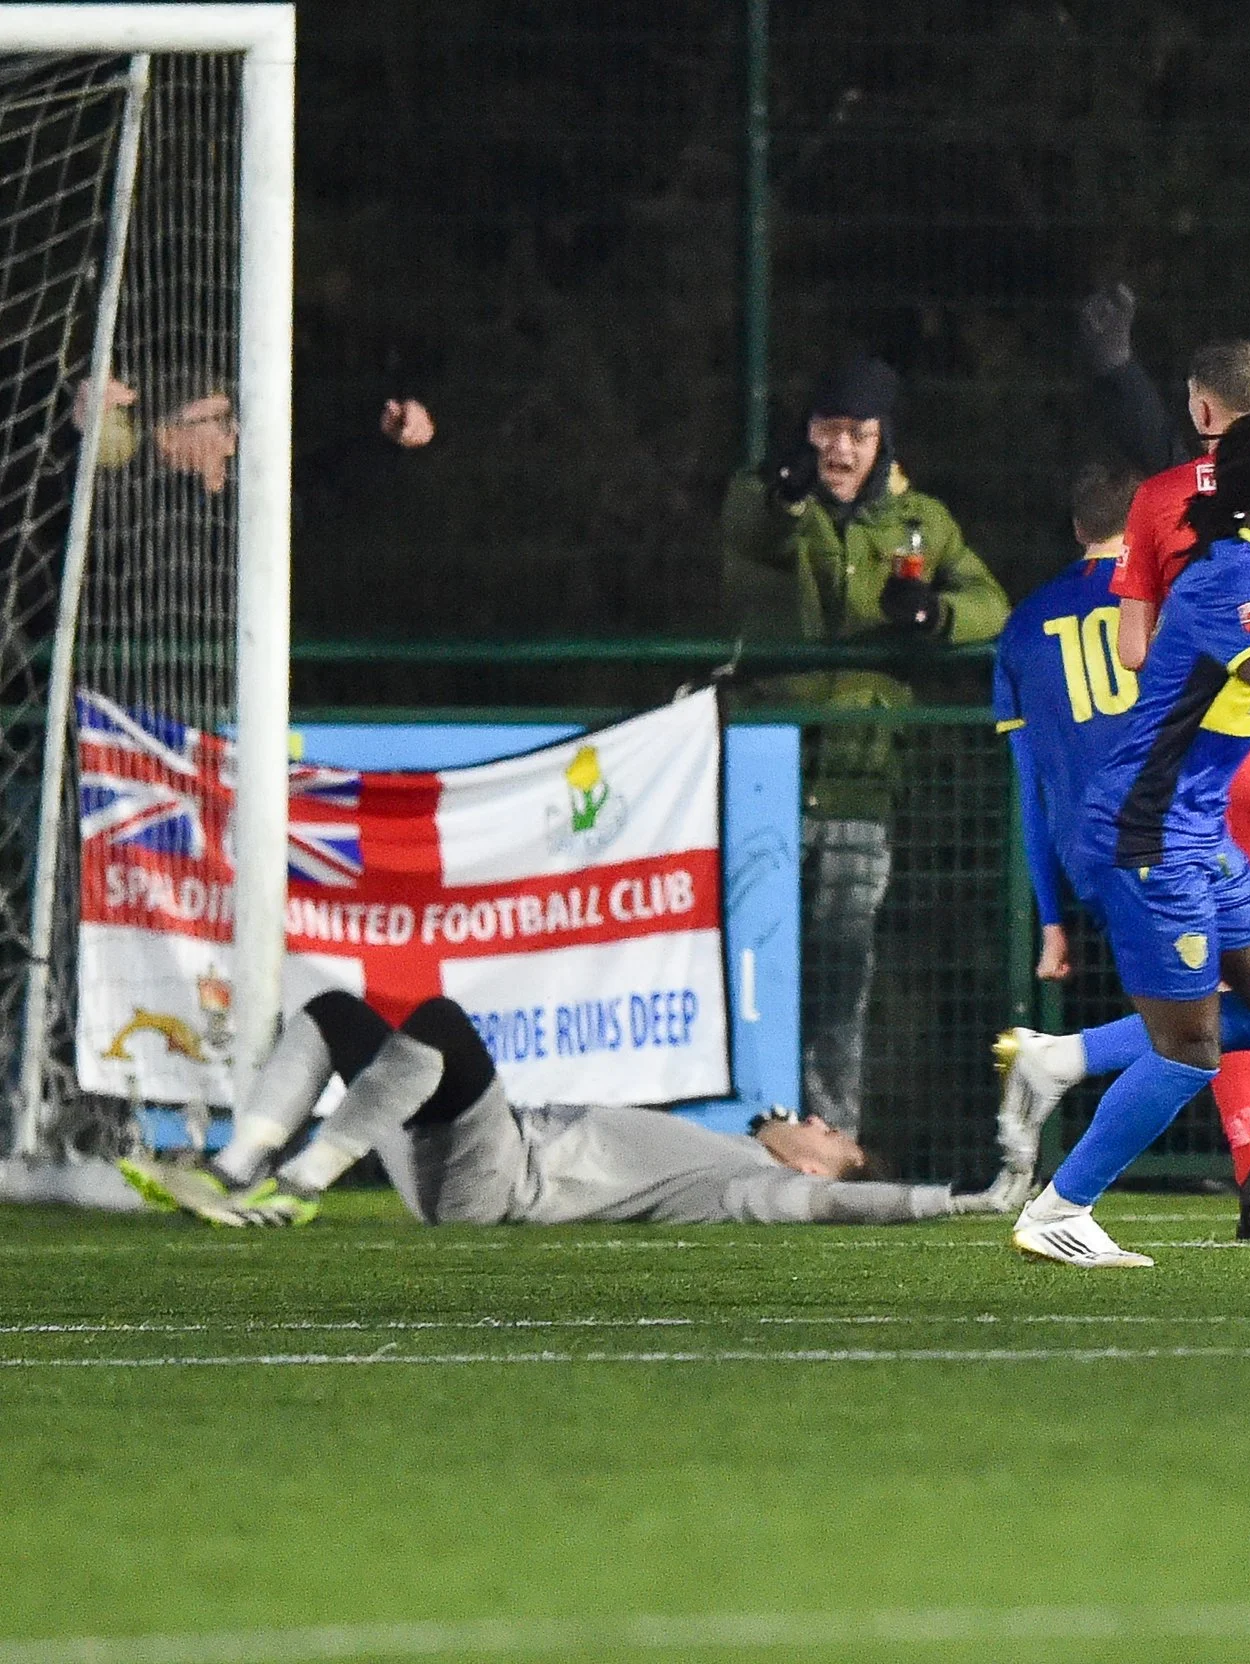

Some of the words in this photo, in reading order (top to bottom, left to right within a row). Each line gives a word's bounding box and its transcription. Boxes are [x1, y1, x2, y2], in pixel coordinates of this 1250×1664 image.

[1043, 606, 1139, 723] 10
[105, 863, 236, 923] SPALDI
[421, 886, 604, 944] FOOTBALL
[608, 869, 695, 922] CLUB
[556, 998, 623, 1056] RUNS
[630, 989, 698, 1049] DEEP
